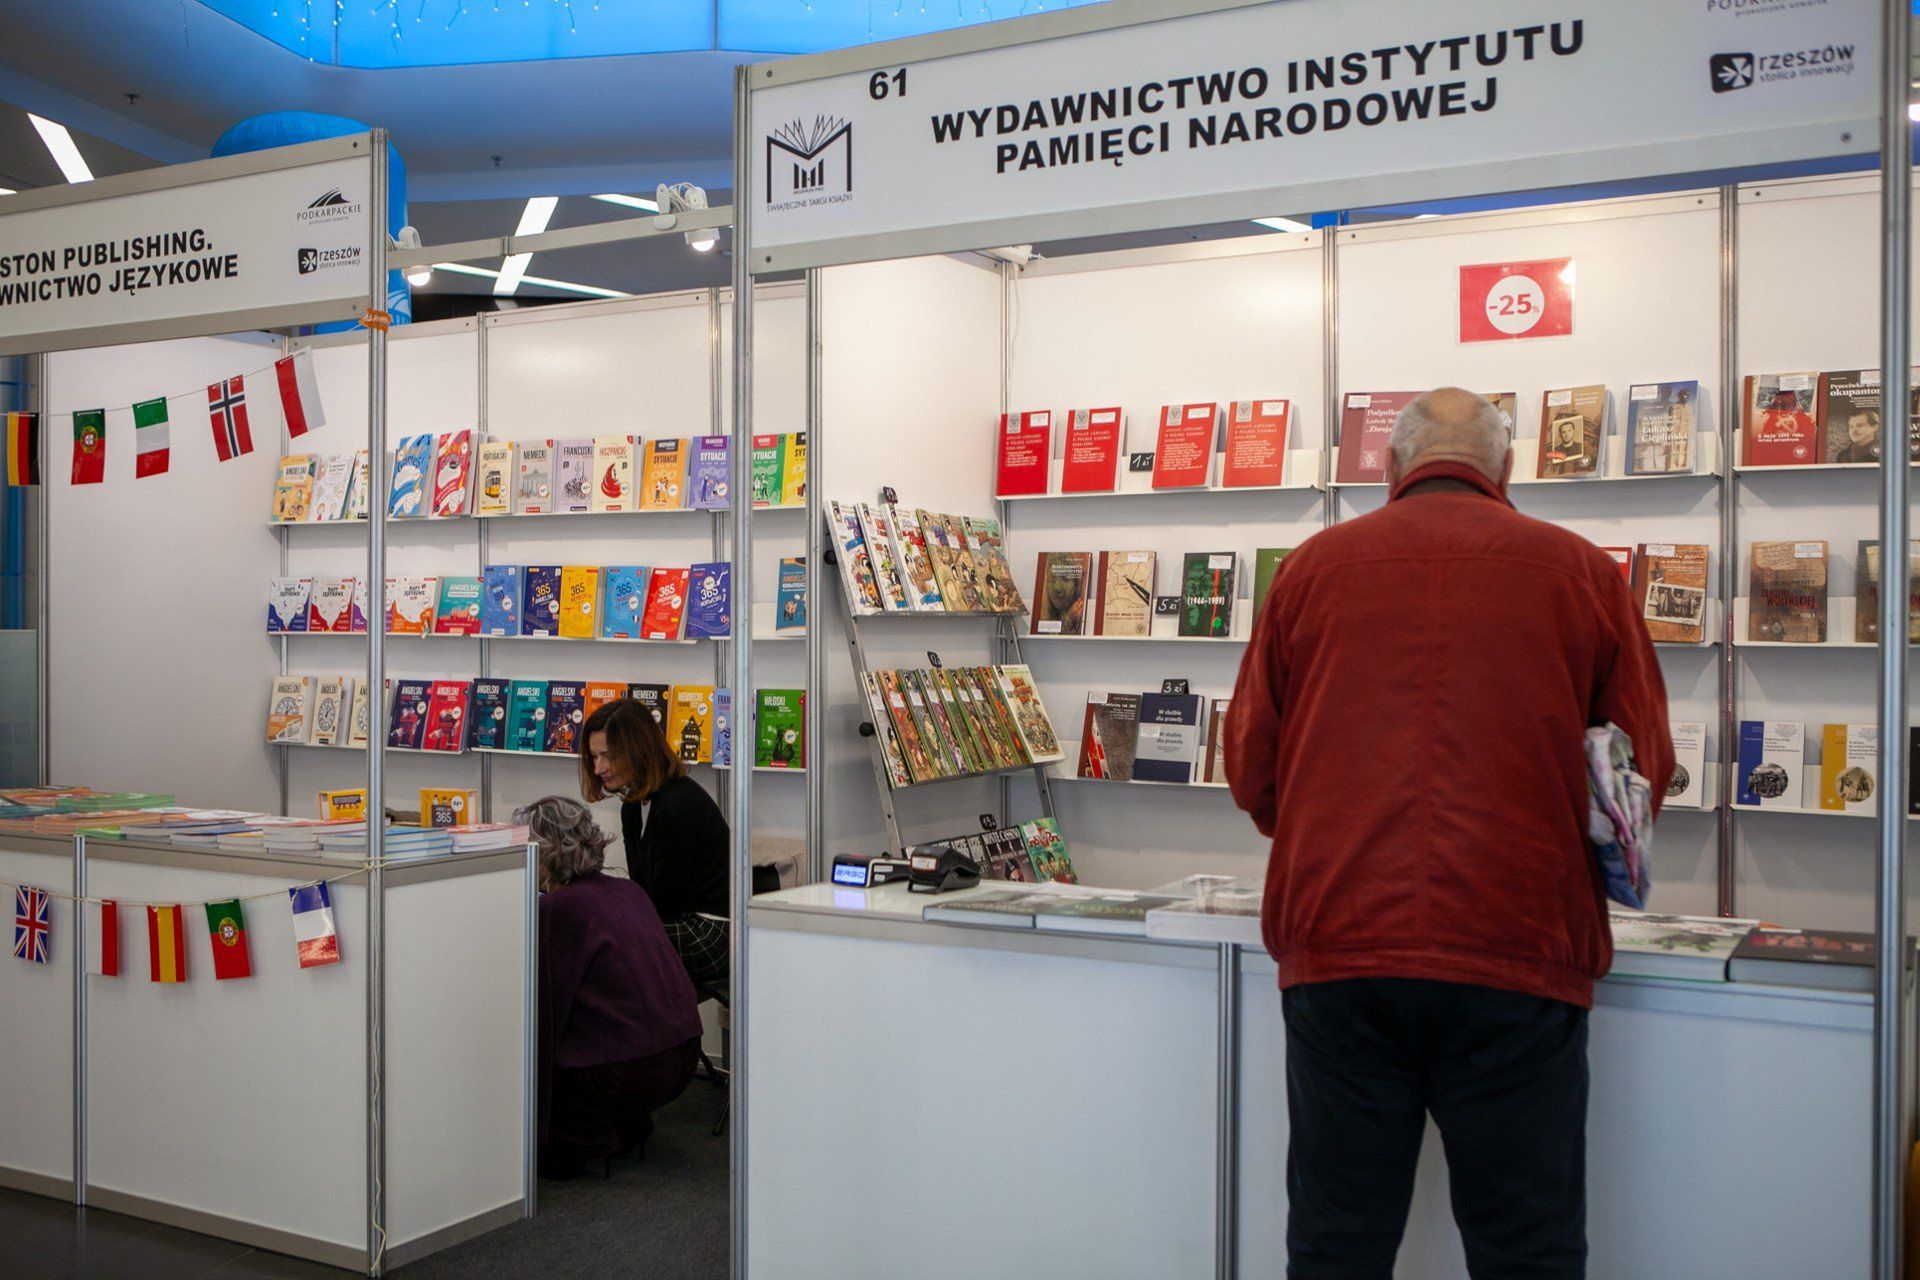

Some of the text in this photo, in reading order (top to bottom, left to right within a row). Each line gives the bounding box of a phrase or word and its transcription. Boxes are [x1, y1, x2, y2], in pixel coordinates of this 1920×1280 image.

[1759, 44, 1855, 71] rzeszów
[869, 68, 907, 100] 61
[931, 19, 1584, 143] WYDAWNICTWO INSTYTUTU
[997, 77, 1498, 174] PAMIĘCI NARODOWEJ
[296, 203, 362, 221] PODKARPACKIE
[0, 228, 213, 278] STON PUBLISHING.
[319, 246, 361, 262] rzeszów
[0, 254, 238, 306] WNICTWO JĘZYKOWE
[1488, 293, 1541, 316] -25%
[563, 445, 593, 456] FRANCUSKI
[700, 450, 727, 461] SYTUACJE
[1132, 454, 1142, 468] 1
[535, 583, 551, 597] 365
[570, 583, 585, 597] 365
[616, 582, 632, 597] 365
[658, 585, 675, 598] 365
[700, 588, 719, 600] 365
[1158, 598, 1169, 612] 5
[476, 684, 499, 694] ANGIELSKI
[516, 687, 540, 697] ANGIELSKI
[551, 686, 576, 696] ANGIELSKI
[591, 688, 616, 698] ANGIELSKI
[632, 689, 658, 700] NIEMIECKI
[1163, 681, 1172, 694] 3
[764, 695, 786, 706] WŁOSKI
[435, 811, 452, 823] 365
